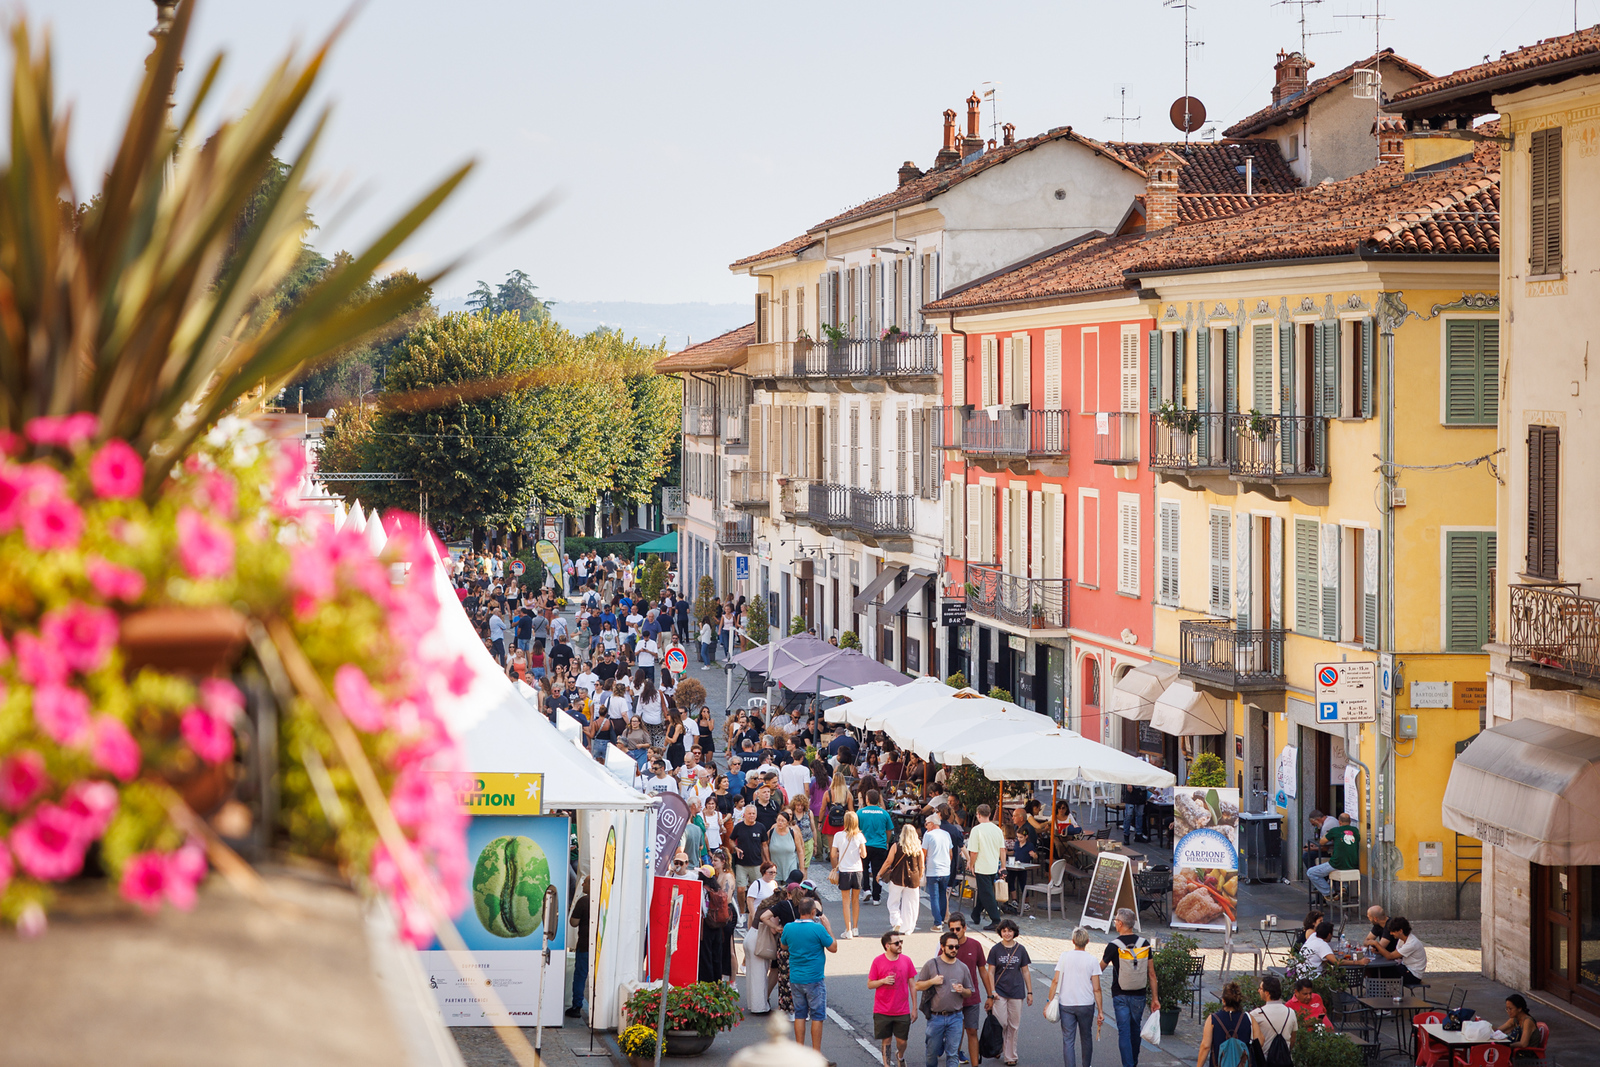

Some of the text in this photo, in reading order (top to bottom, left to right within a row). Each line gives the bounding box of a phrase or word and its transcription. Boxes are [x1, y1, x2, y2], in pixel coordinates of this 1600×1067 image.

[1324, 705, 1334, 718] P
[1488, 825, 1504, 847] STUDIO
[1185, 850, 1225, 858] CARPIONE
